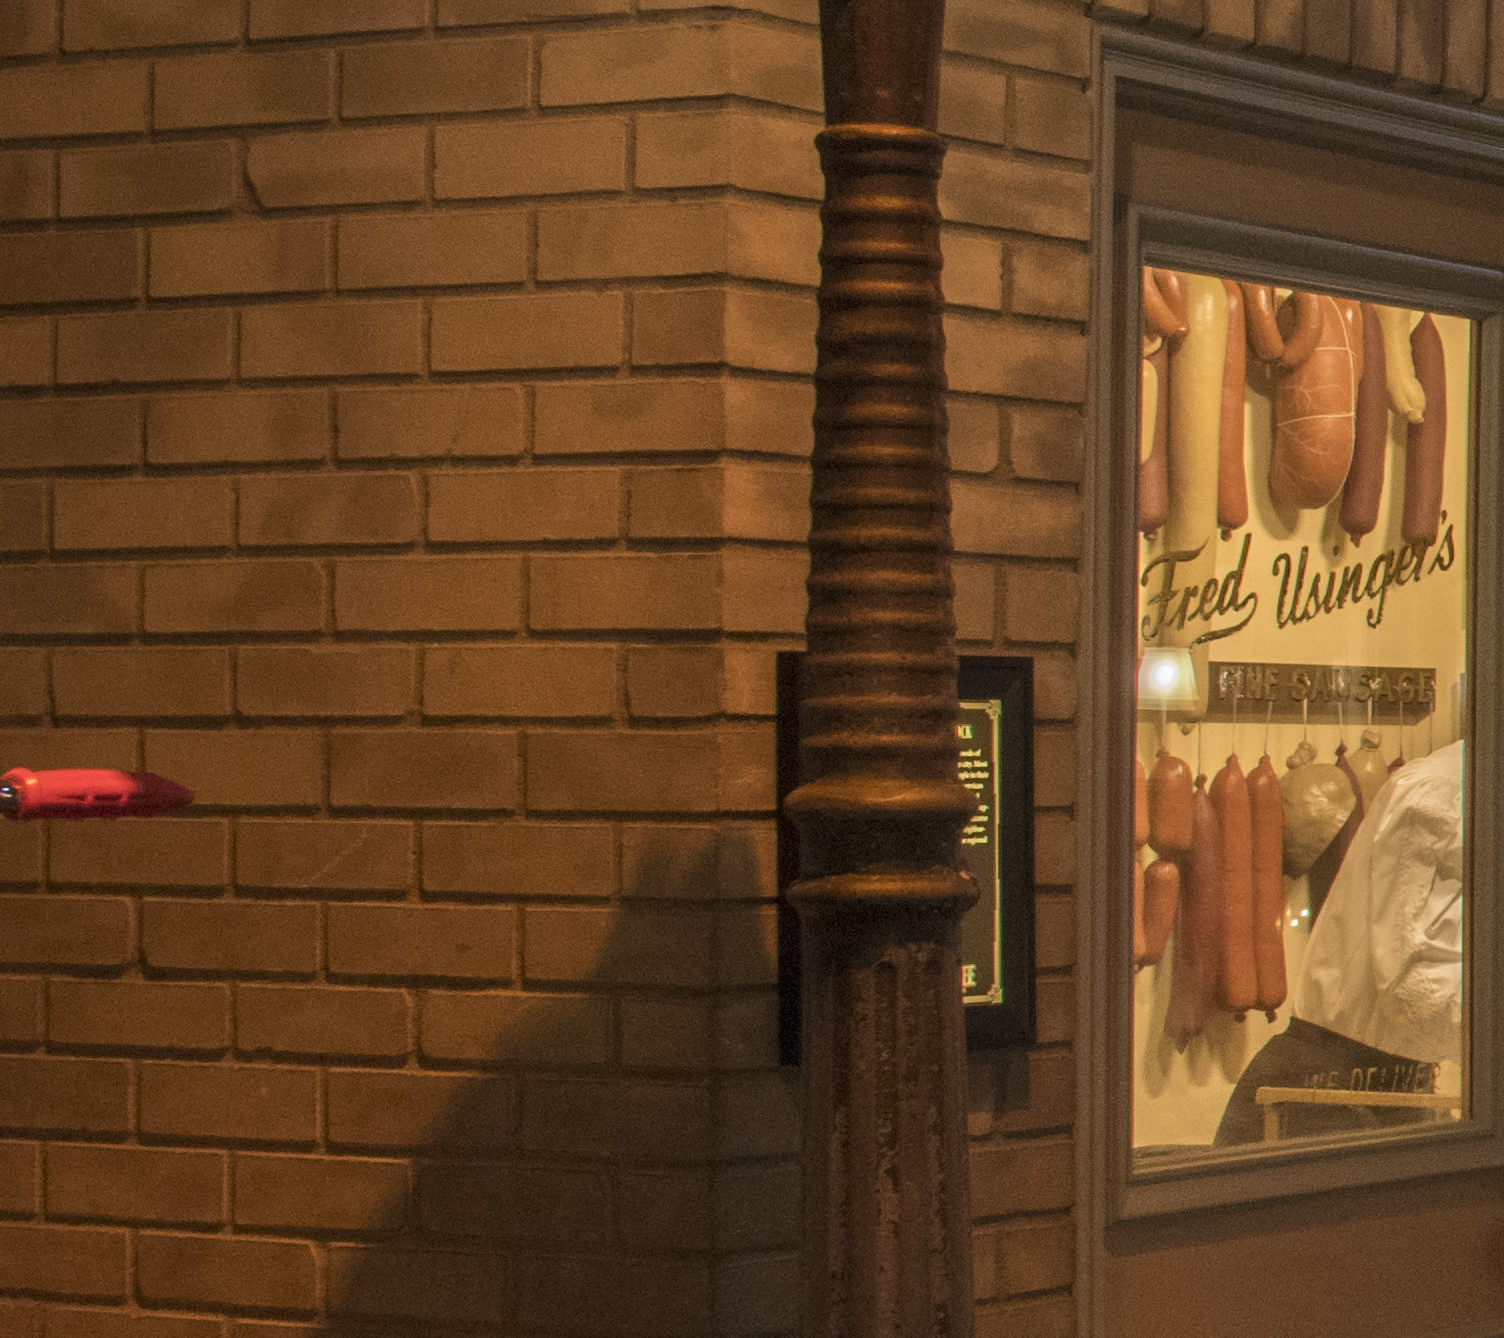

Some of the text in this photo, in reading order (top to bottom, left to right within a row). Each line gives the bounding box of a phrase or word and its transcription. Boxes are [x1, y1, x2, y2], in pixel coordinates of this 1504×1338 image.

[1141, 509, 1455, 649] Fred Usinger's
[1291, 668, 1434, 704] SAUSAGE
